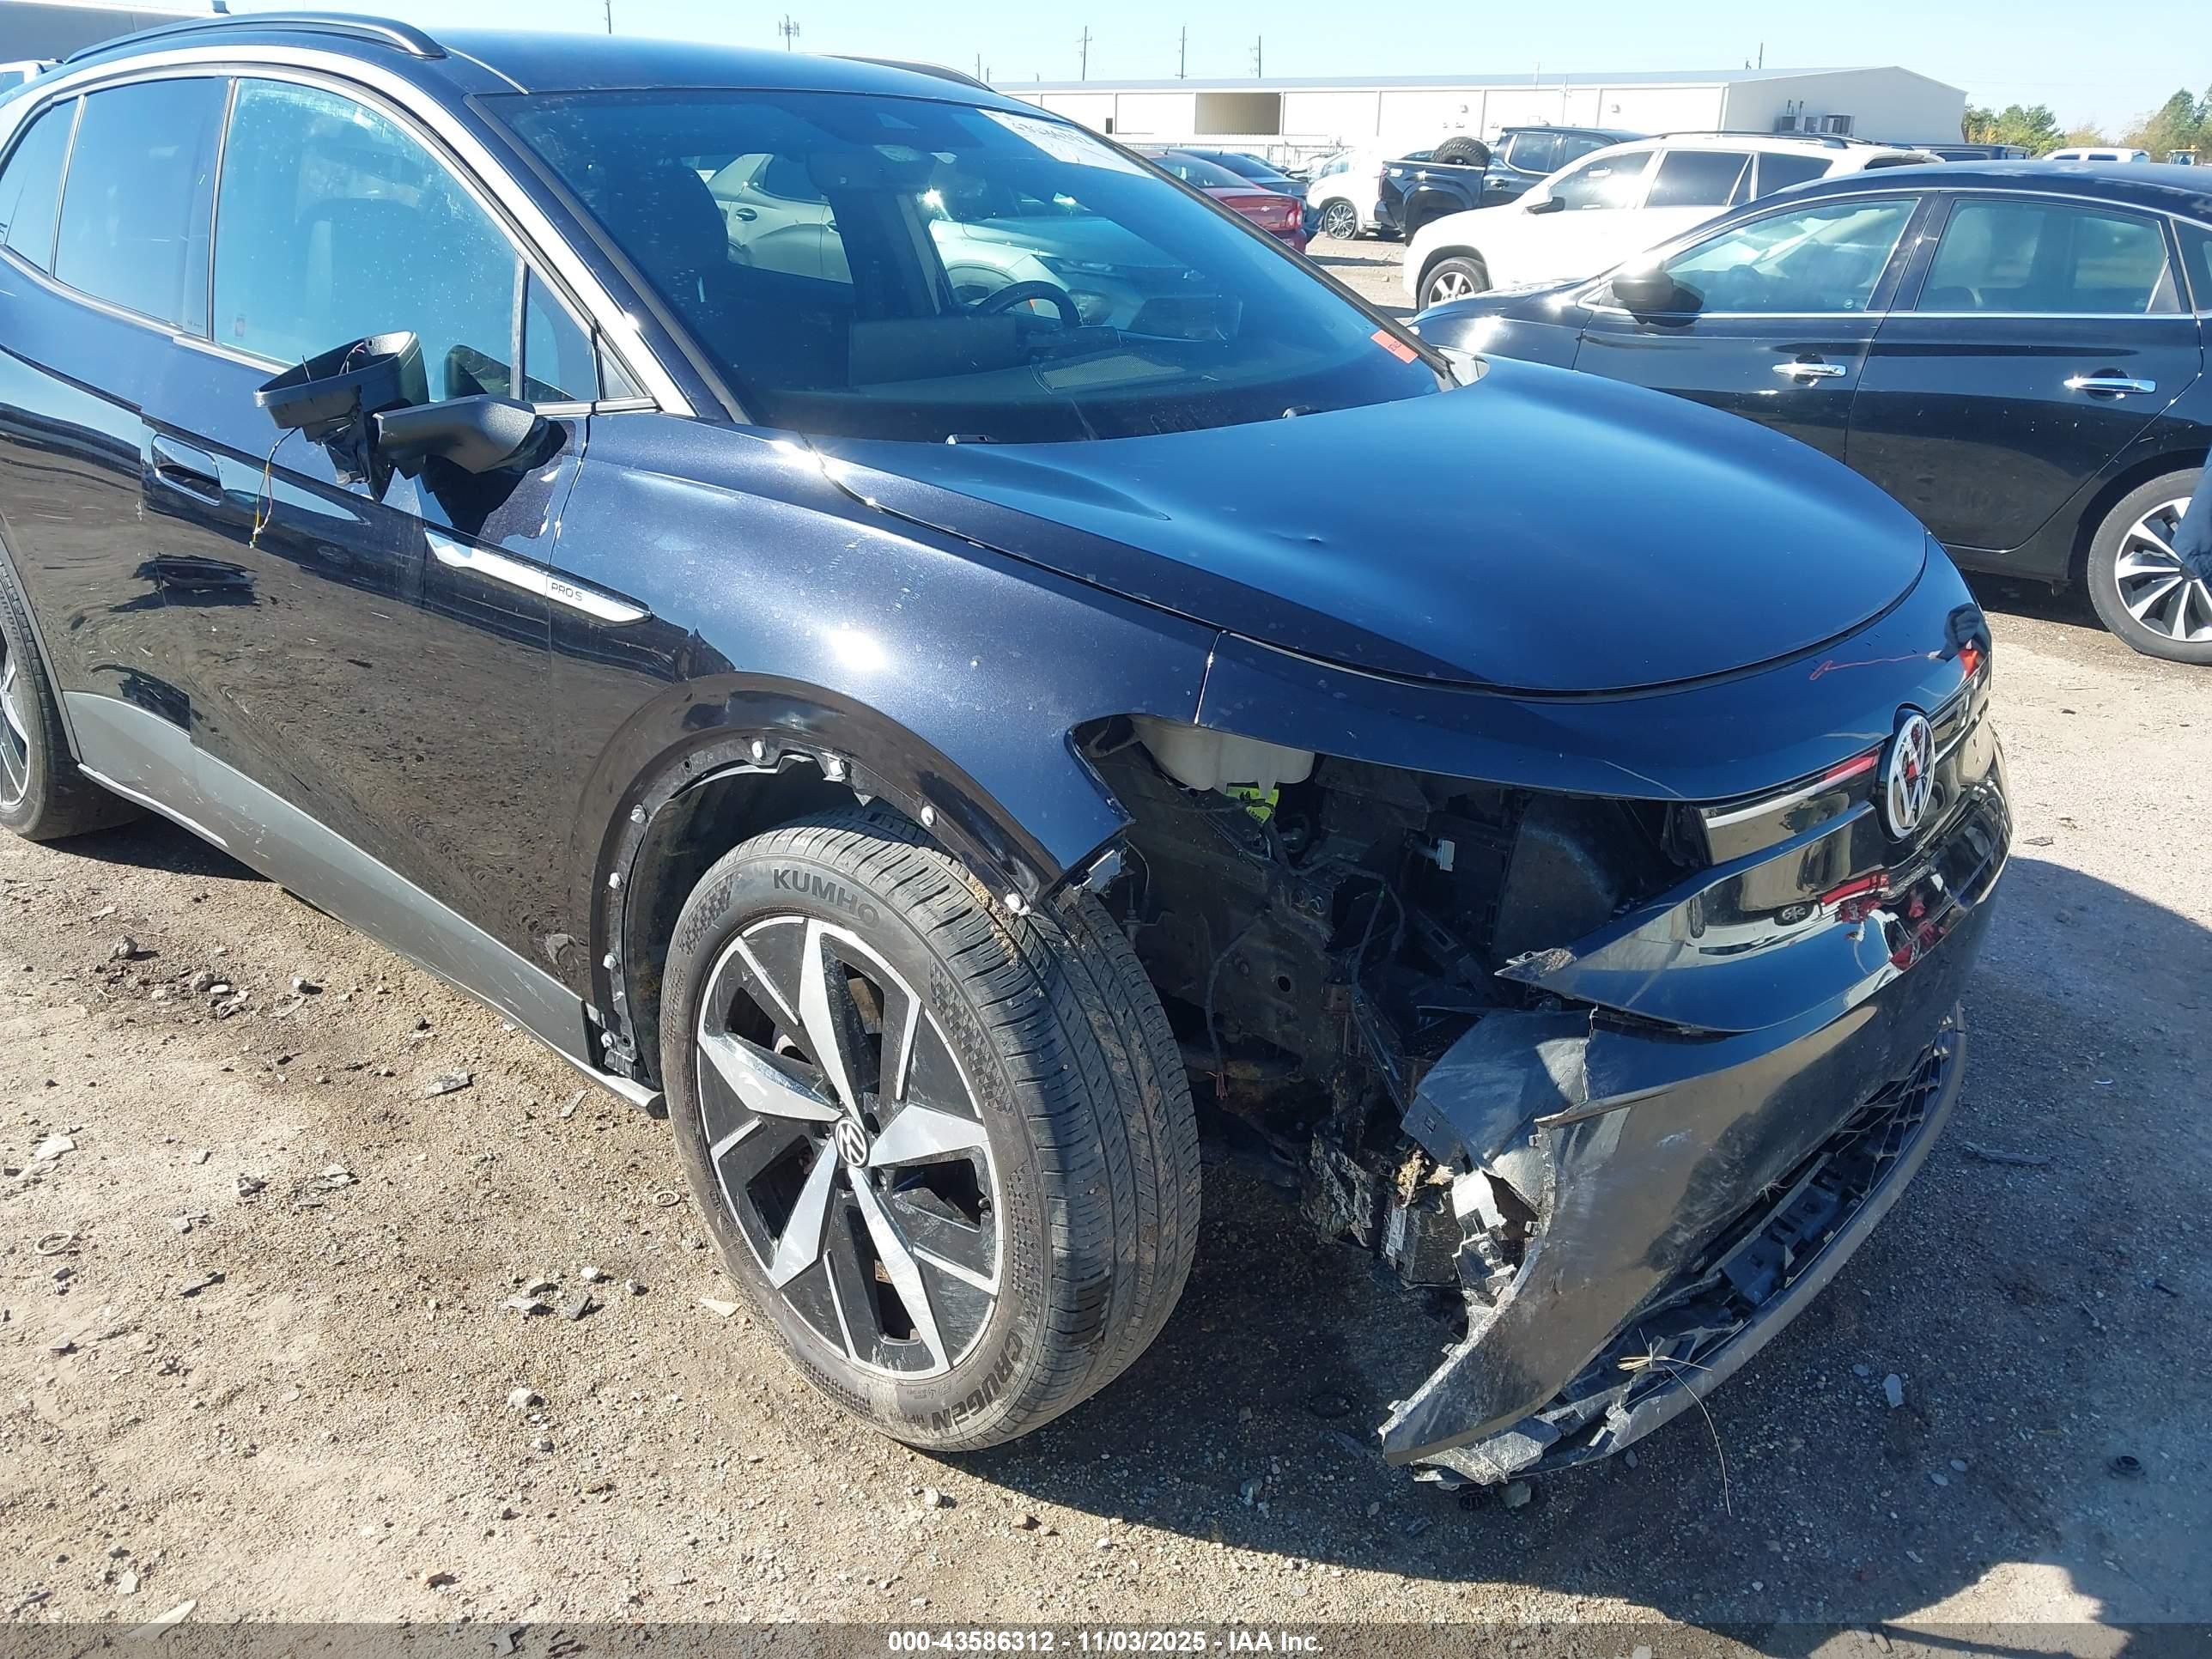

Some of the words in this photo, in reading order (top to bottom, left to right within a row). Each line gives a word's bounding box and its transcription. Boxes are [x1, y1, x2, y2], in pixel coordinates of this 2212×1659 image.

[551, 582, 574, 598] PRO
[575, 591, 583, 601] S
[774, 869, 880, 928] KUMHO
[932, 1328, 1023, 1431] CRUGEN
